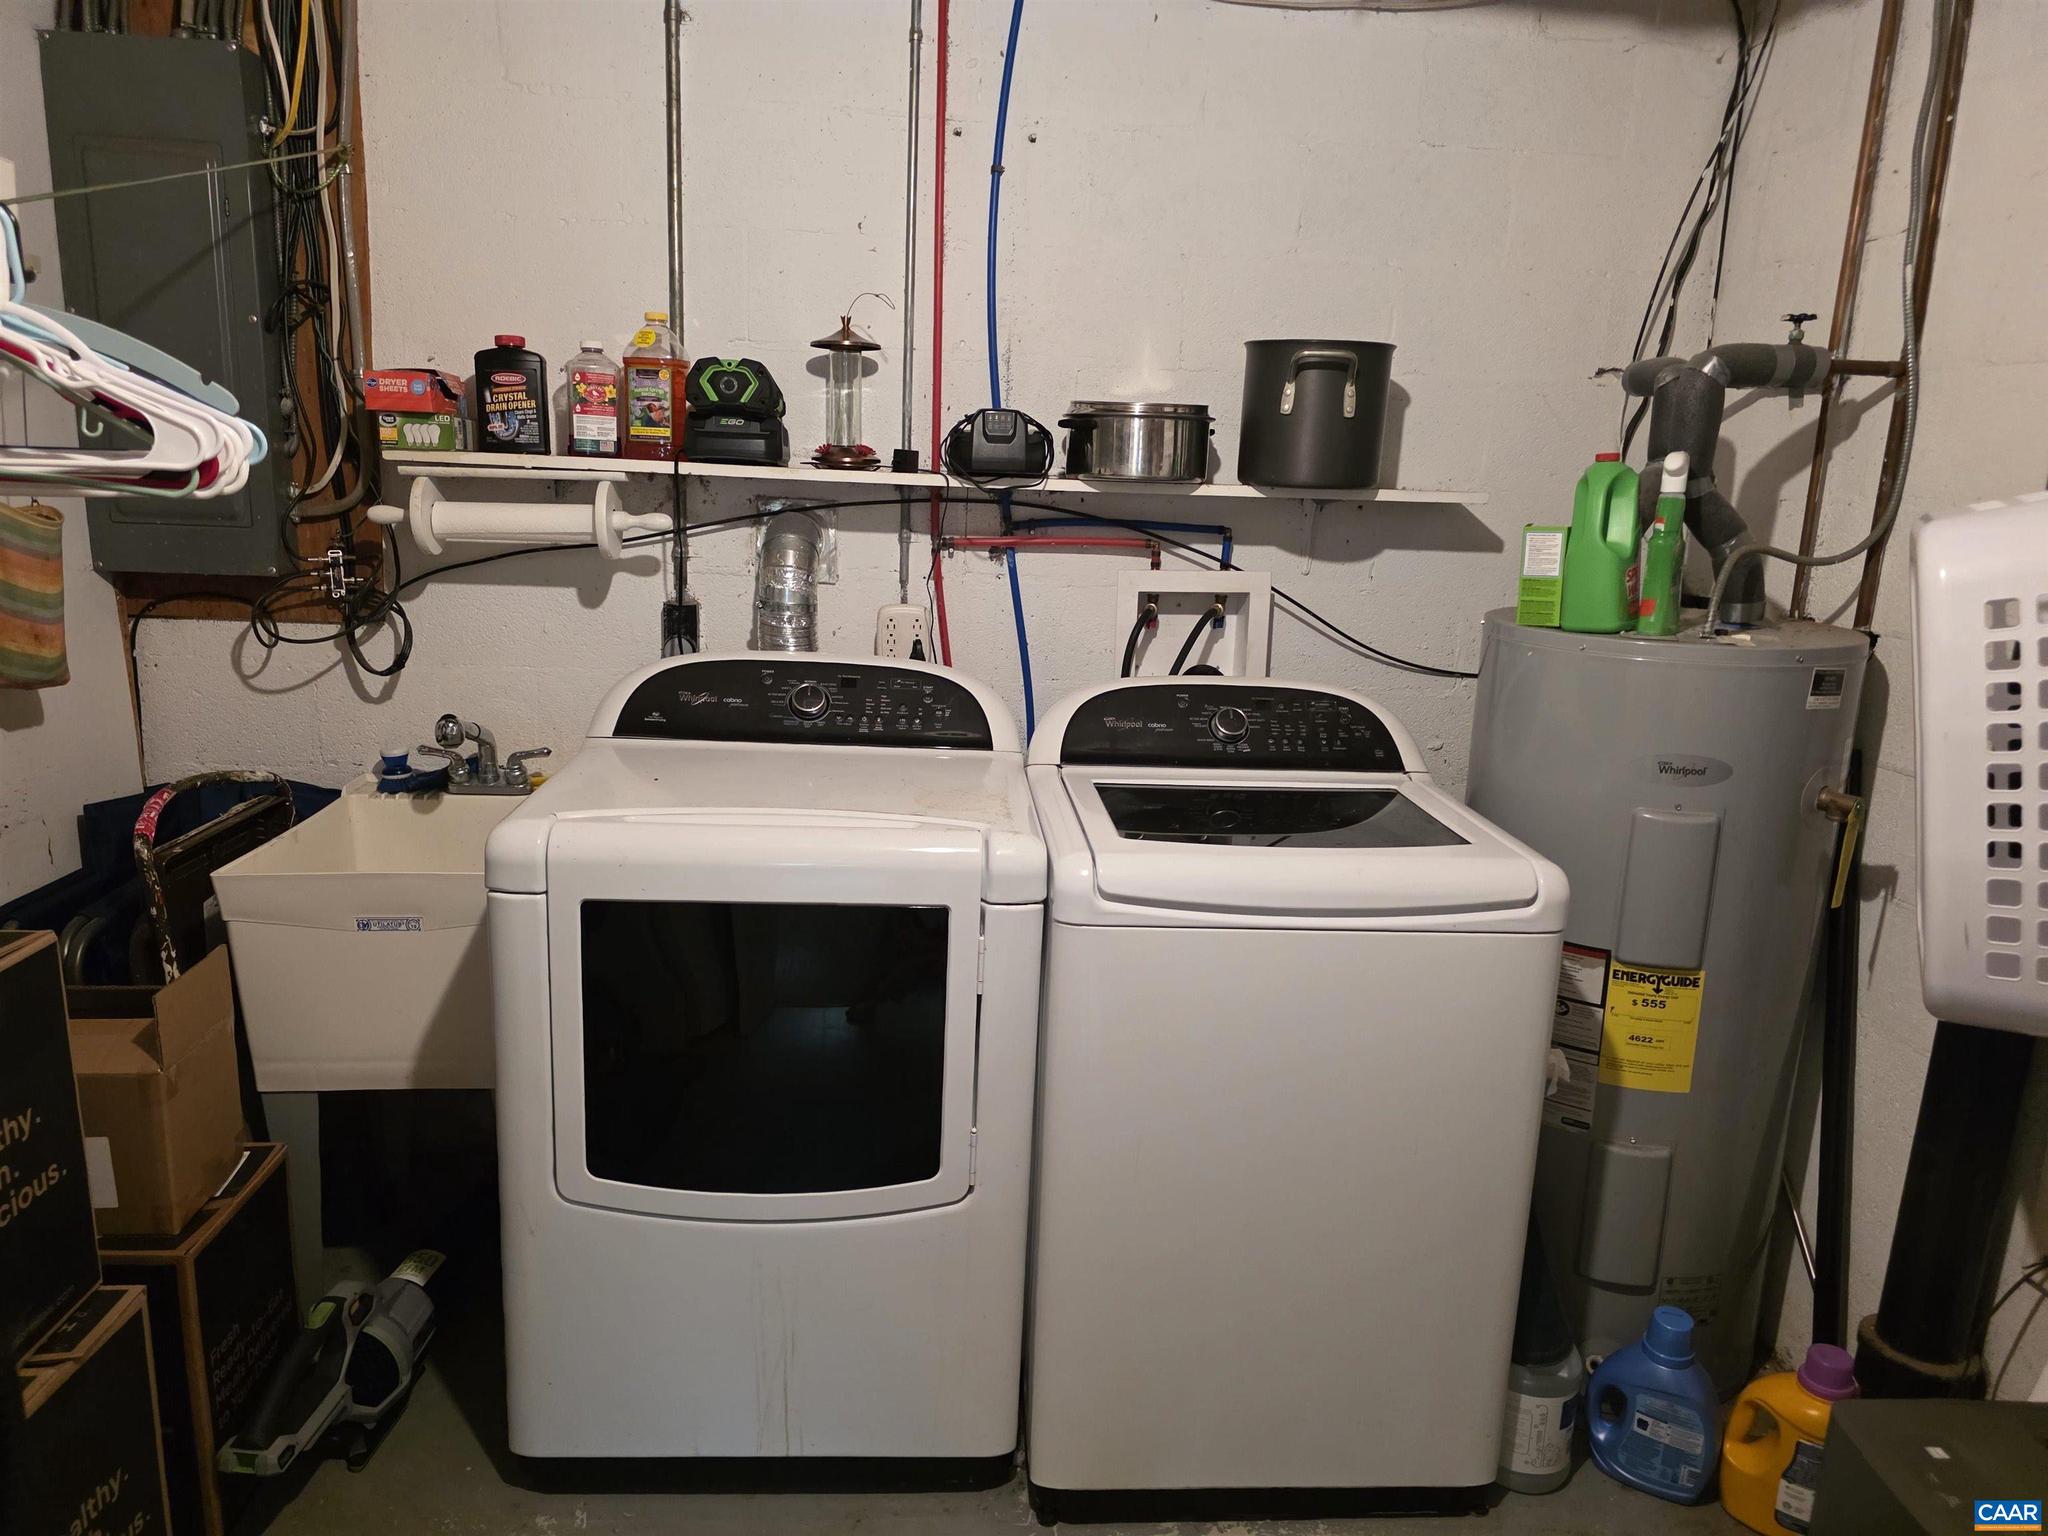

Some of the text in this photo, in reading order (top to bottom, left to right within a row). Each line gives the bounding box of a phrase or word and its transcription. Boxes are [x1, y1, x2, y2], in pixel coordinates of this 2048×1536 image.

[379, 378, 408, 386] DRYER
[379, 385, 408, 393] SHEETS
[492, 391, 528, 403] CRYSTAL
[485, 400, 537, 413] DRAIN OPENER
[434, 414, 451, 422] LED
[1105, 721, 1143, 729] Whirlpool
[1659, 765, 1708, 778] Whirlpool
[1612, 969, 1701, 989] ENERGYGUIDE
[1631, 998, 1667, 1009] $ 555
[1628, 1034, 1654, 1044] 4622
[0, 1107, 41, 1147] hy.
[68, 1466, 129, 1536] althy.
